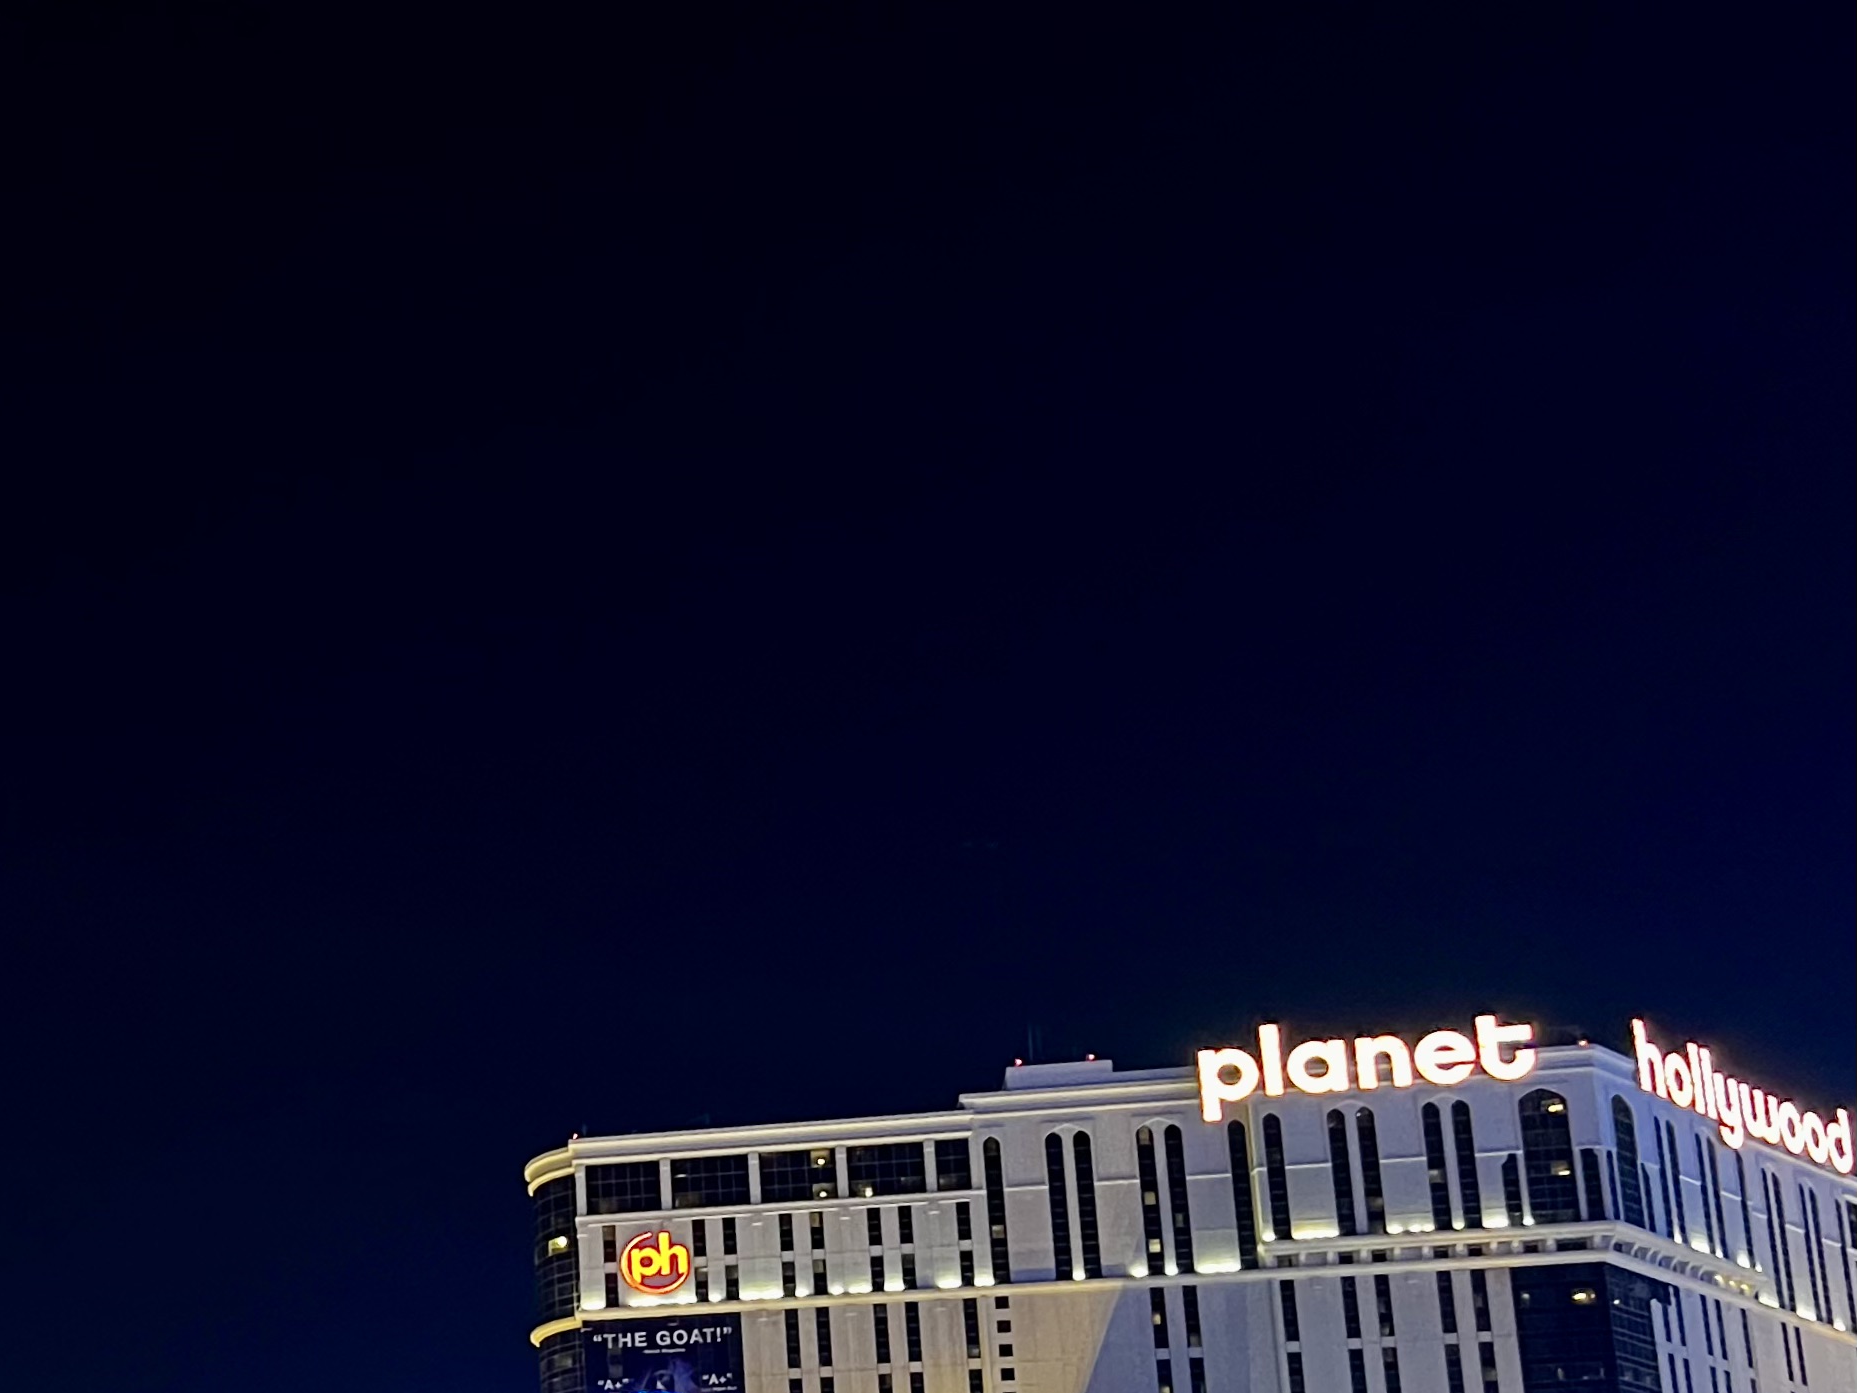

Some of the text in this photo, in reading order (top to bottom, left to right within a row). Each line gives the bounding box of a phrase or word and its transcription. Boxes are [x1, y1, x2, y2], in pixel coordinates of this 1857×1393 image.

[1197, 1013, 1856, 1174] planet hollywood
[630, 1232, 689, 1283] ph
